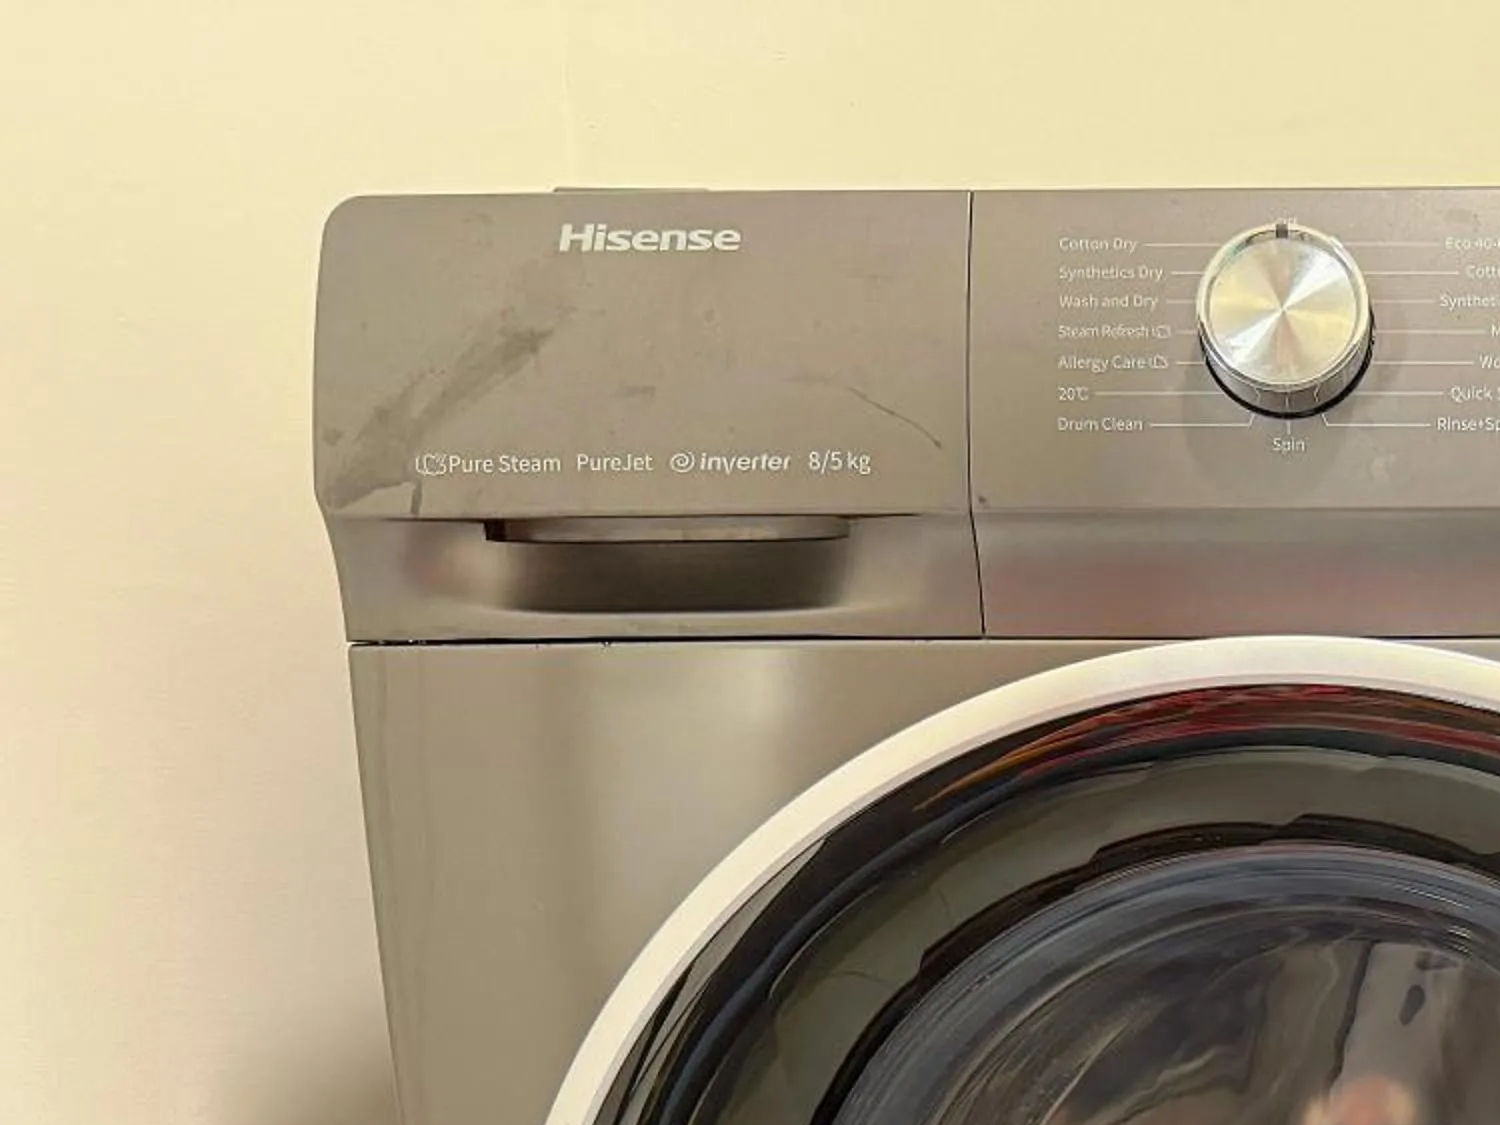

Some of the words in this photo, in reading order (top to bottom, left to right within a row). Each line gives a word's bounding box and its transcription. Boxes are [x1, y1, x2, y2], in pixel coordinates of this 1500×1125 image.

[559, 223, 742, 252] Hisense
[1059, 238, 1110, 251] Cotton
[1113, 238, 1138, 253] Dry
[1445, 237, 1471, 250] Eco
[1059, 265, 1135, 282] Synthetics
[1138, 266, 1164, 282] Dry
[1059, 295, 1099, 308] Wash
[1101, 295, 1129, 308] and
[1133, 295, 1159, 312] Dry
[1058, 325, 1100, 337] Steam
[1102, 325, 1149, 337] Refresh
[1058, 355, 1109, 373] Allergy
[1111, 356, 1147, 369] Care
[1451, 385, 1493, 403] Quick
[1058, 418, 1099, 431] Drum
[1102, 417, 1143, 431] Clean
[1273, 437, 1305, 453] Spin
[449, 455, 494, 473] Pure
[498, 455, 561, 473] Steam
[576, 454, 654, 472] PureJet
[700, 453, 792, 475] inverter
[807, 450, 843, 475] 8/5
[847, 451, 872, 475] kg
